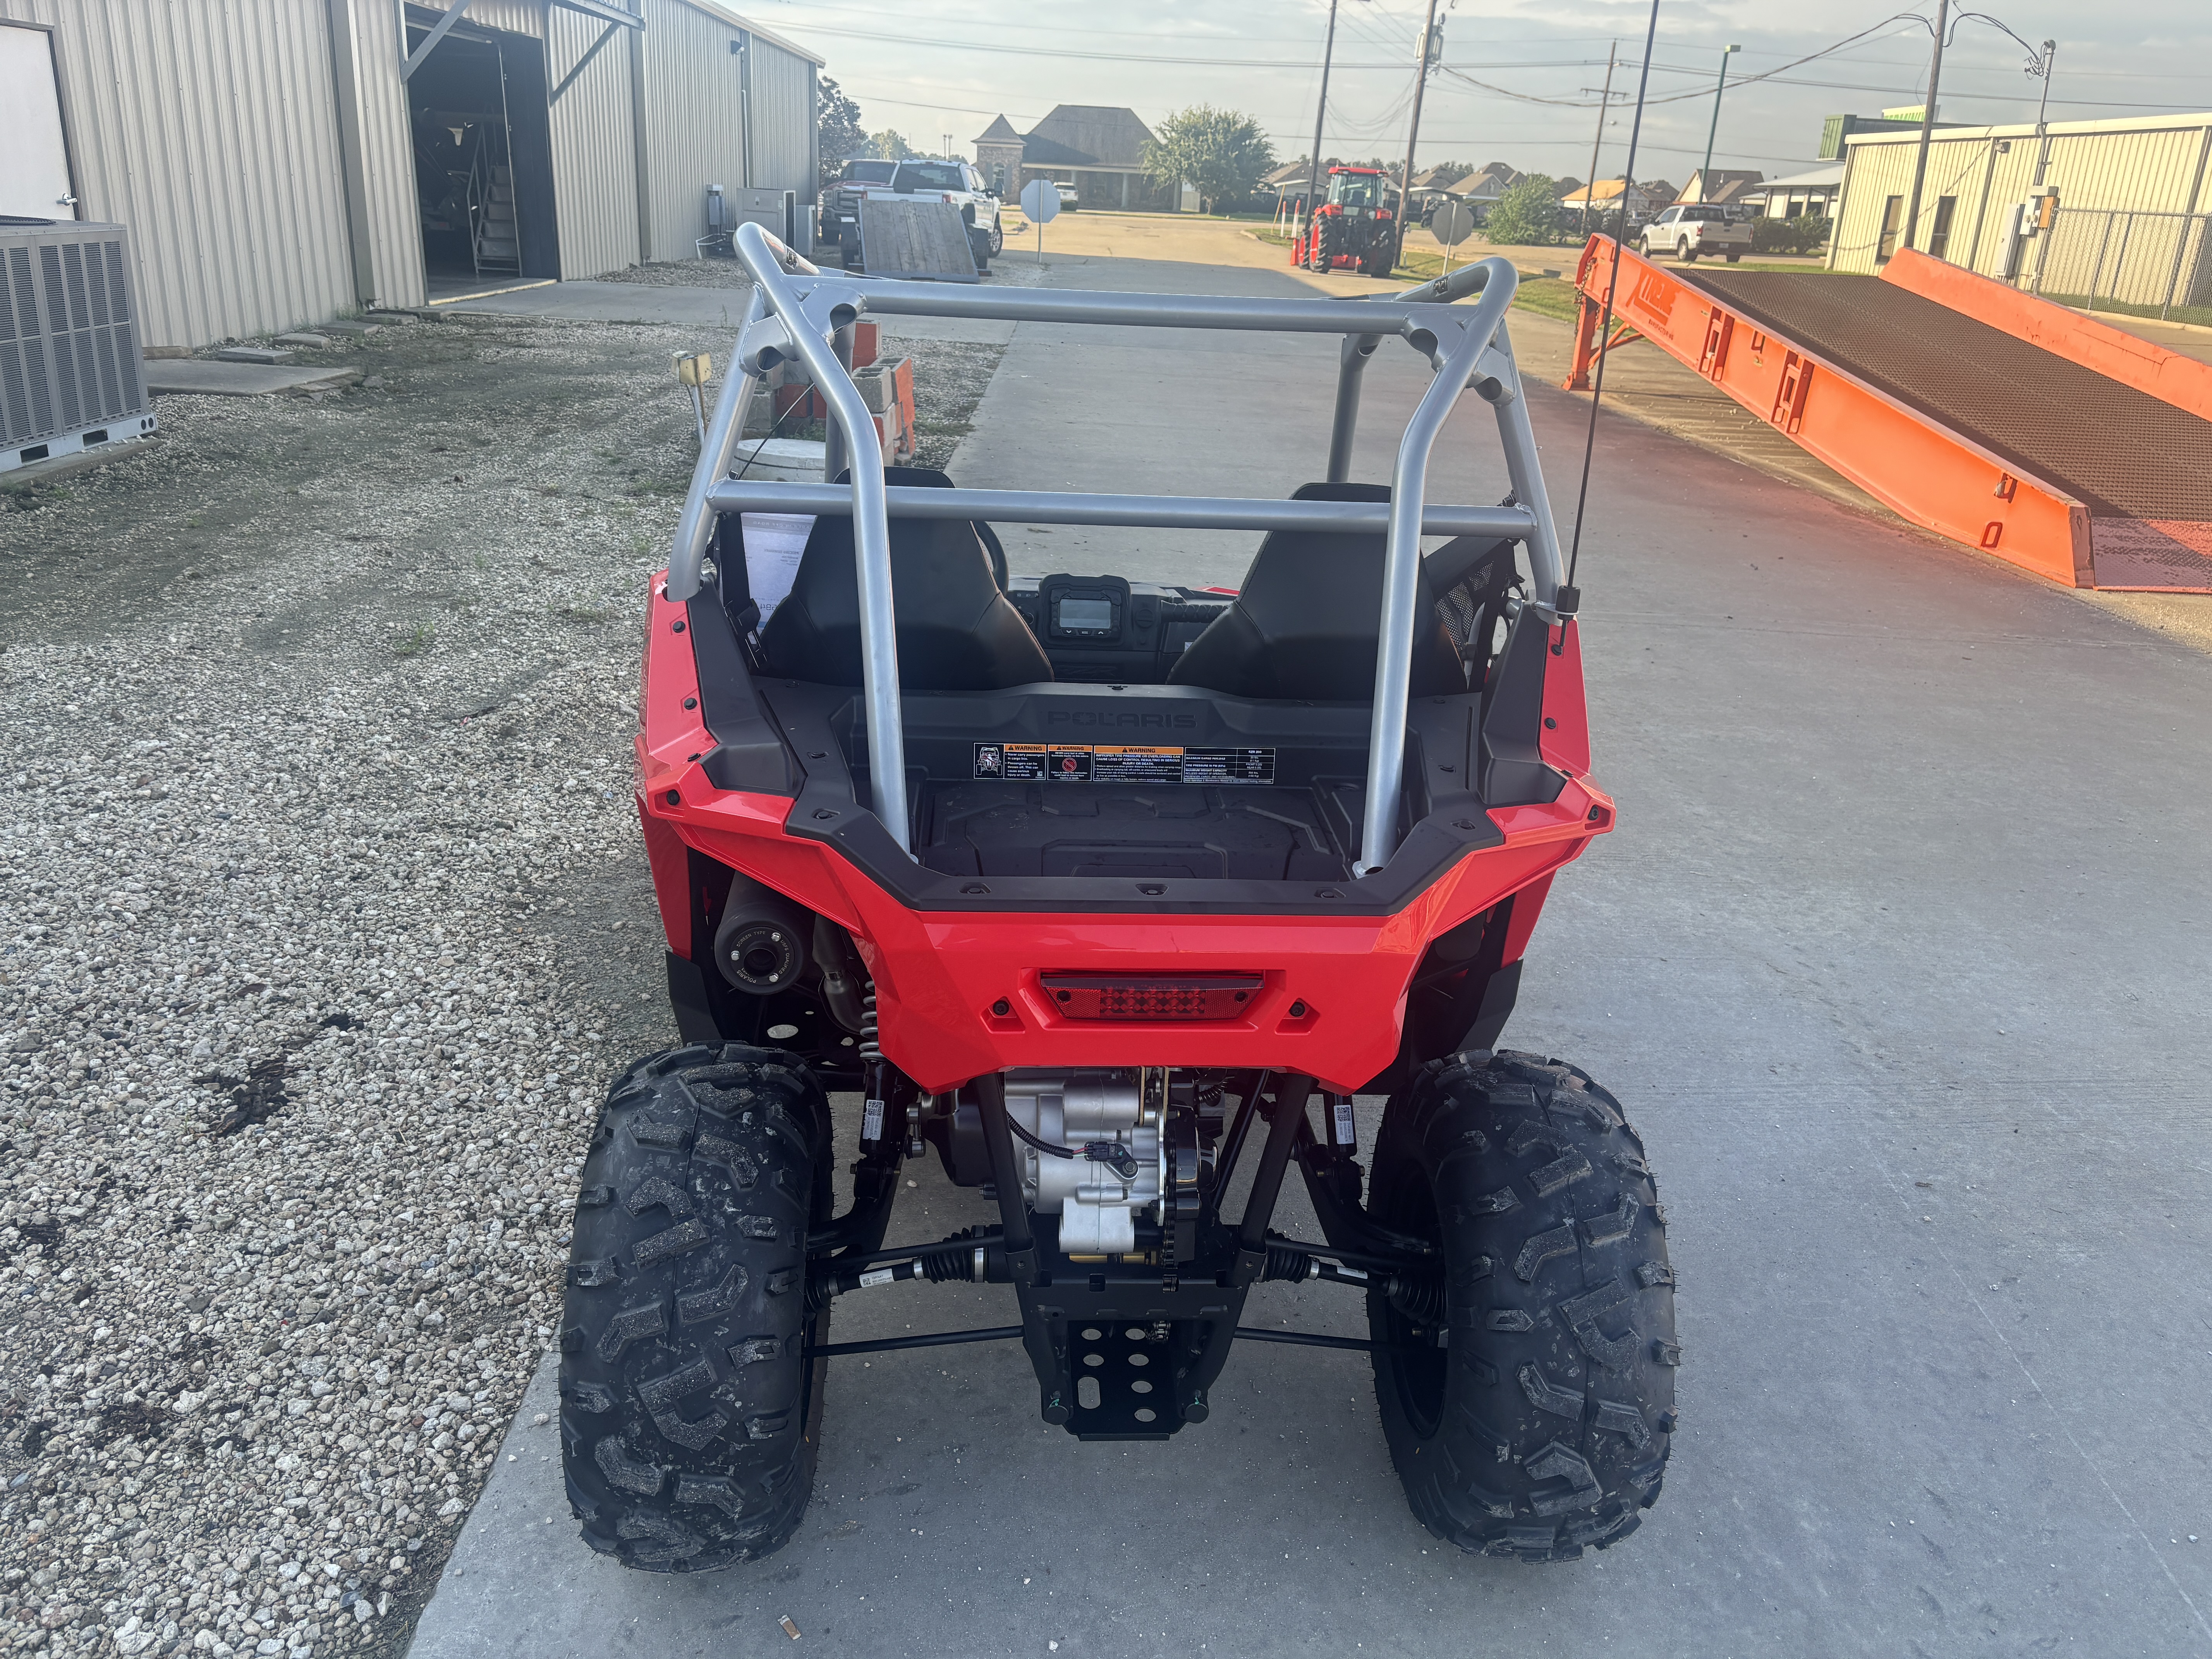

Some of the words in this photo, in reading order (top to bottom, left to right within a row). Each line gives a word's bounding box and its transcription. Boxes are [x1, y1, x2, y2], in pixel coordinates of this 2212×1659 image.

[1048, 711, 1197, 728] POLARIS
[737, 933, 752, 947] SCREEN
[780, 939, 789, 951] USFS
[737, 969, 757, 984] POLARIS
